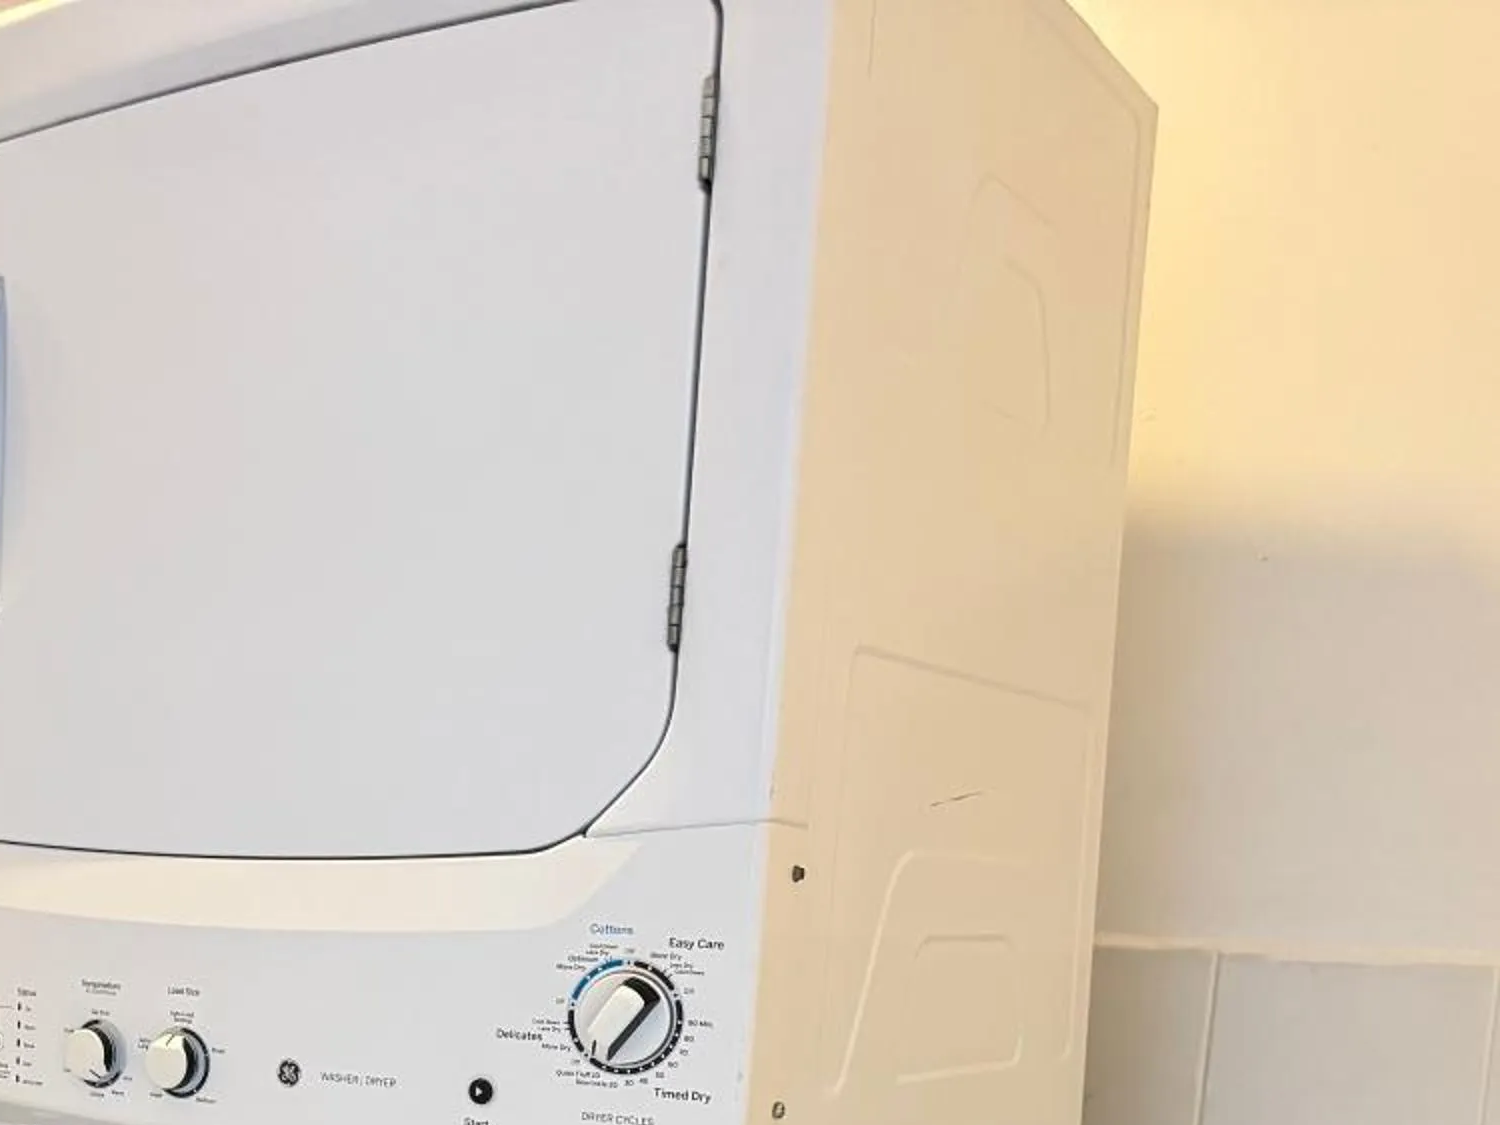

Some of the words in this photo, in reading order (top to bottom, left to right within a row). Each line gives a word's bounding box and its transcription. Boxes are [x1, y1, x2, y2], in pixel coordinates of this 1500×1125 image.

[589, 923, 634, 935] Cottons
[669, 937, 695, 950] Easy
[697, 938, 725, 950] Care
[497, 1027, 543, 1041] Delicates
[654, 1087, 688, 1101] Timed
[691, 1091, 712, 1104] Dry
[581, 1111, 613, 1123] DRYER
